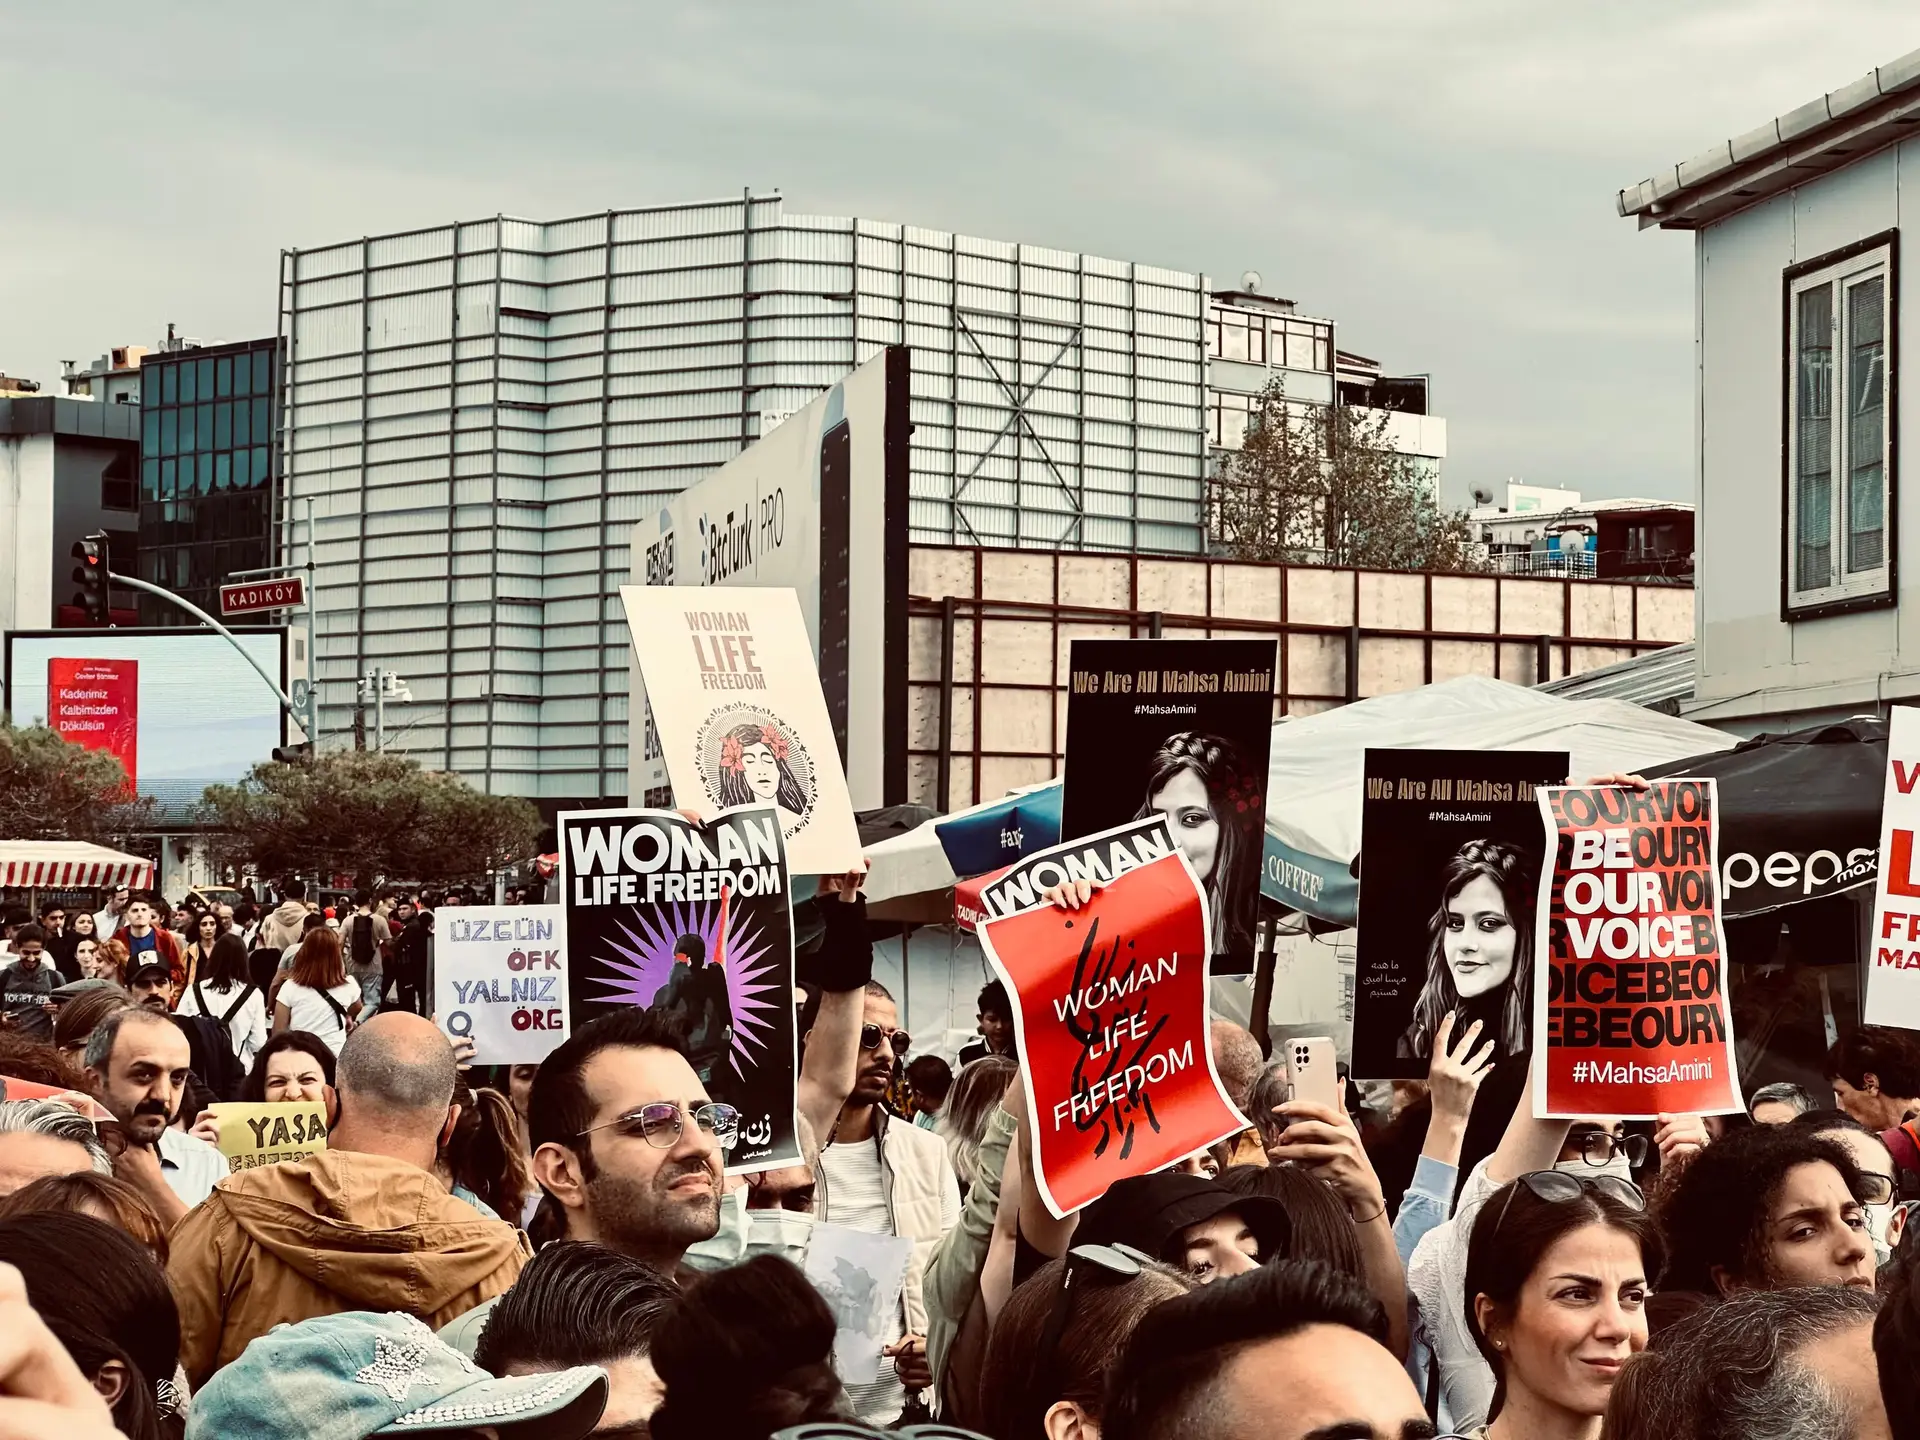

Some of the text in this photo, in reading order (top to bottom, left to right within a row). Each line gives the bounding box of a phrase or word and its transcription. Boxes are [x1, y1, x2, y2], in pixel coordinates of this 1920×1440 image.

[710, 487, 784, 585] BtcTurk PRO
[229, 585, 293, 607] KADIKÖY
[684, 611, 750, 631] WOMAN
[692, 635, 761, 672] LIFE
[700, 673, 766, 690] FREEDOM
[1073, 669, 1271, 694] We Are All Mahsa Amini
[60, 704, 118, 716] Kalbimizden
[1134, 703, 1197, 715] #MahsaAmini
[60, 720, 105, 732] Dökülsün
[1367, 777, 1393, 800] We
[1397, 778, 1426, 801] Are
[1430, 779, 1452, 801] All
[1456, 779, 1513, 802] Mahsa
[1429, 811, 1492, 822] #MahsaAmini
[568, 817, 780, 876] WOMAN
[989, 828, 1168, 918] WOMAN
[1722, 847, 1879, 900] pep
[1836, 858, 1878, 884] max
[575, 865, 782, 907] LIFE.FREEDOM
[450, 917, 553, 942] ÜZGÜN
[1564, 914, 1696, 960] VOICE
[507, 948, 561, 971] ÖFK
[1391, 960, 1399, 969] ما
[452, 976, 557, 1004] YALNIZ
[1053, 952, 1178, 1023] WOMAN
[1385, 973, 1407, 986] مهسا
[1369, 989, 1398, 999] هستیم
[511, 1005, 563, 1031] ÖRG
[1087, 1010, 1149, 1061] LIFE
[1572, 1056, 1713, 1084] #MahsaAmini
[1053, 1040, 1195, 1132] FREEDOM
[247, 1113, 327, 1149] YAŞA
